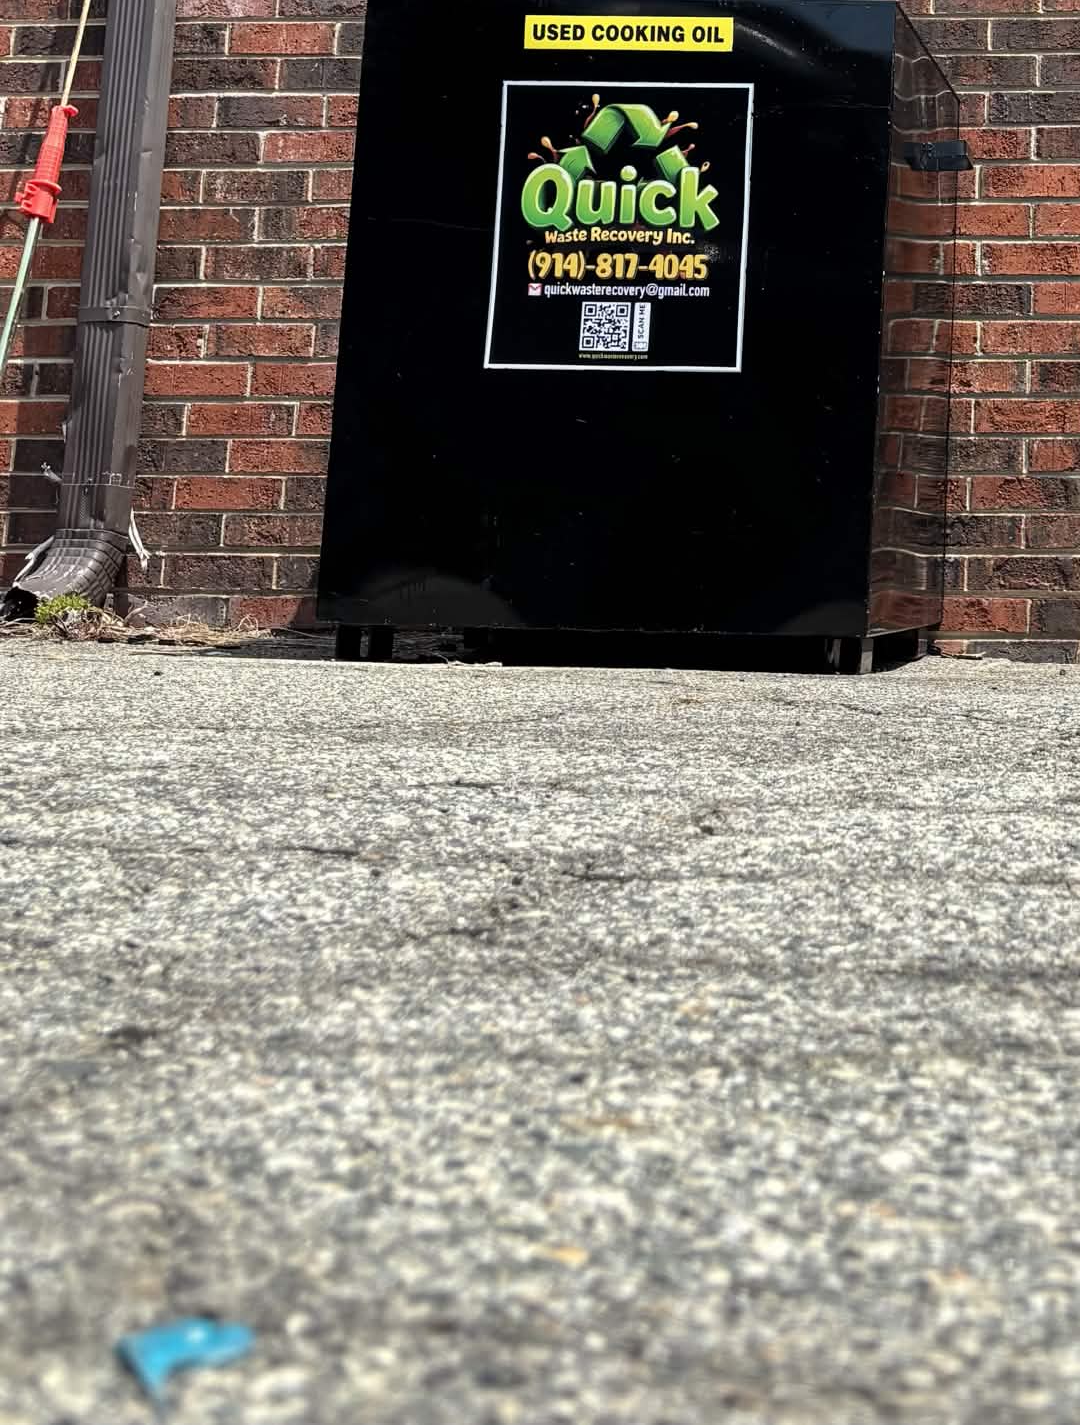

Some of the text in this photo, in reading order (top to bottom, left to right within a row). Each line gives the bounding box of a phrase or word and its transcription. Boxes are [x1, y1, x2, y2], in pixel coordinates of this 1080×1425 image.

[532, 24, 725, 43] USED COOKING OIL
[521, 163, 720, 231] Quick
[544, 227, 696, 246] Waste Recovery Inc.
[527, 250, 709, 280] (914)-817-4045
[544, 283, 710, 299] quickwasterecovery@gmail.com
[637, 304, 646, 339] SCAN ME
